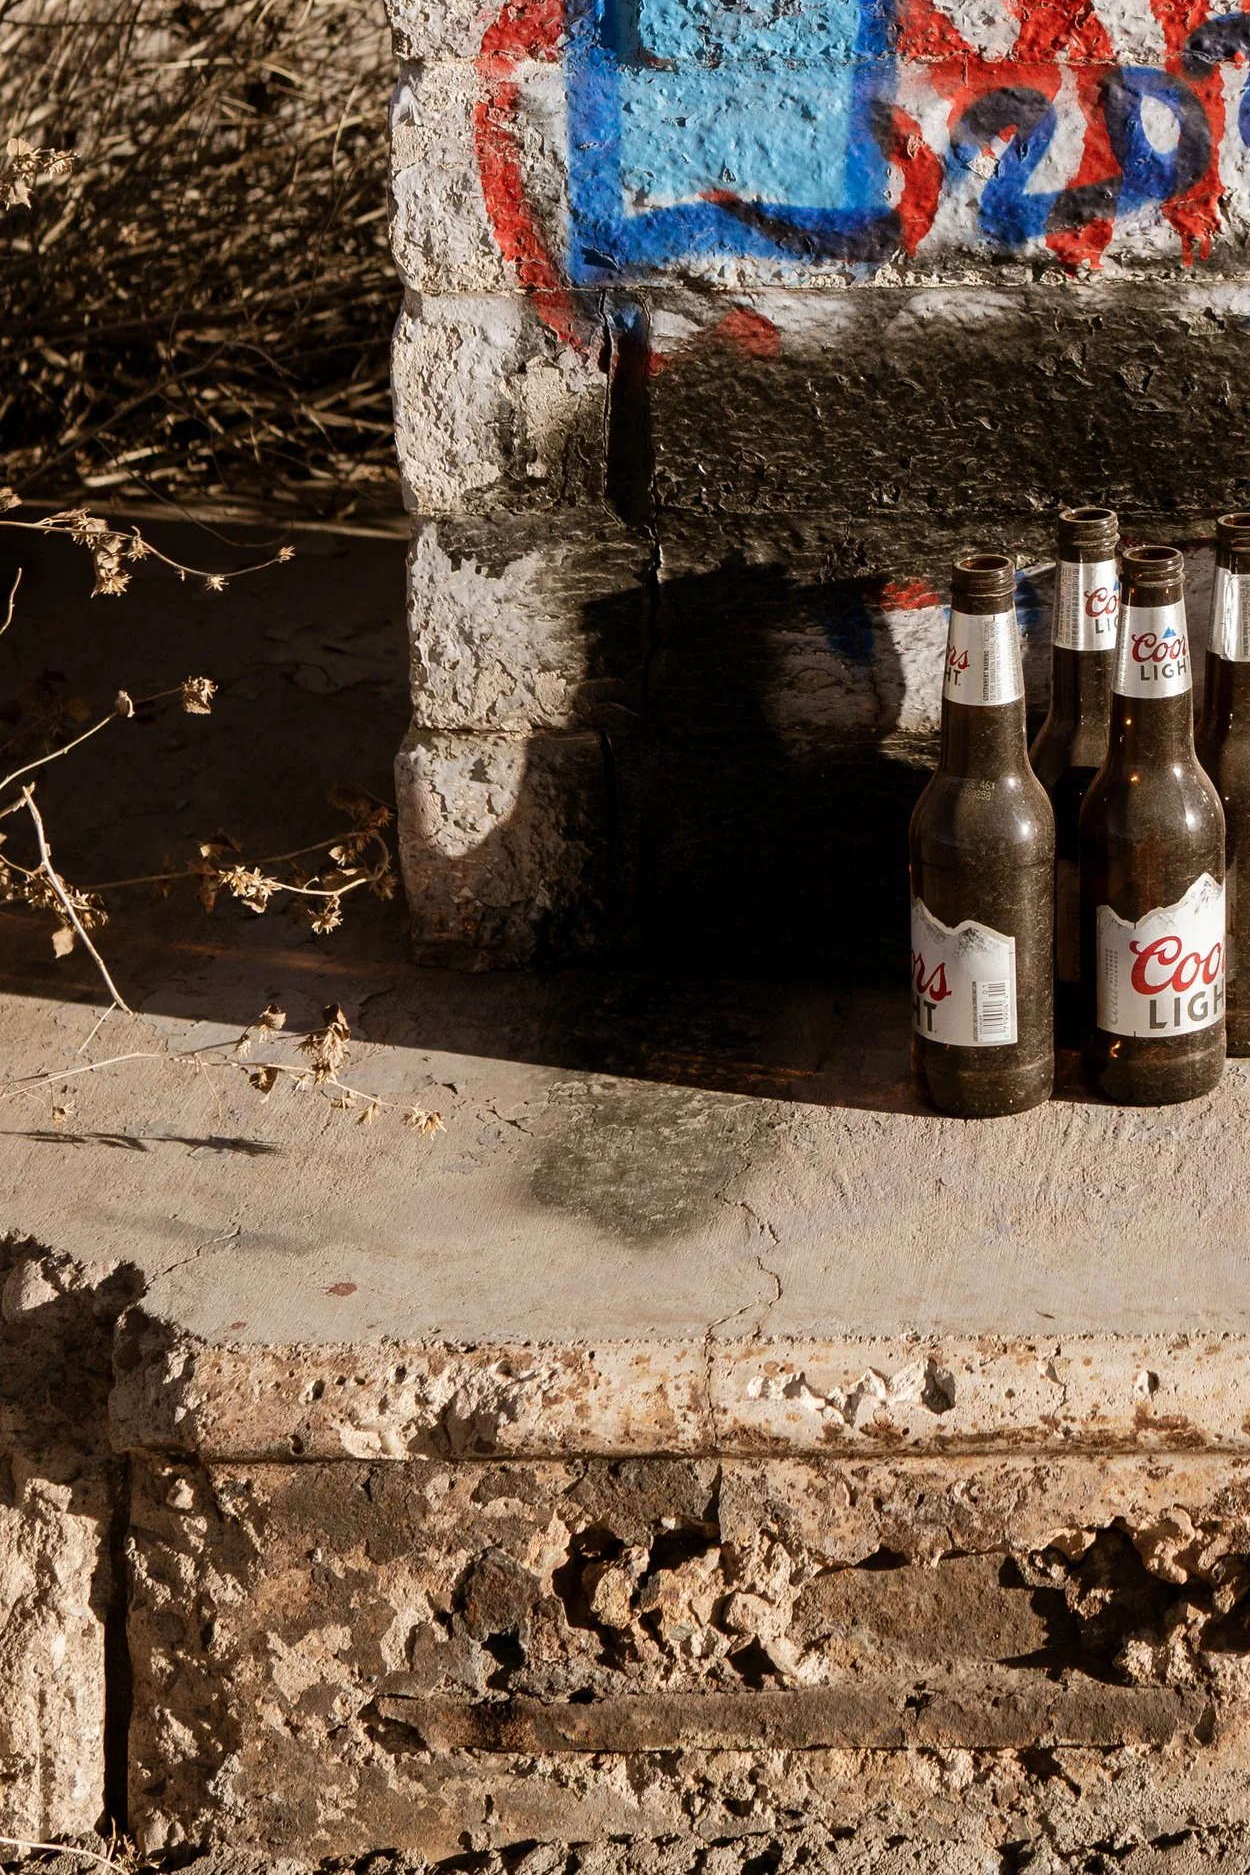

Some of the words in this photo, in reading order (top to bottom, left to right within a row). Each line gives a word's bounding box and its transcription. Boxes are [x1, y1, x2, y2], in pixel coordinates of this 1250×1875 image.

[1131, 632, 1188, 663] Coor
[1140, 658, 1190, 681] LIGH
[1129, 936, 1225, 995] Coo
[1149, 978, 1225, 1030] LIGH
